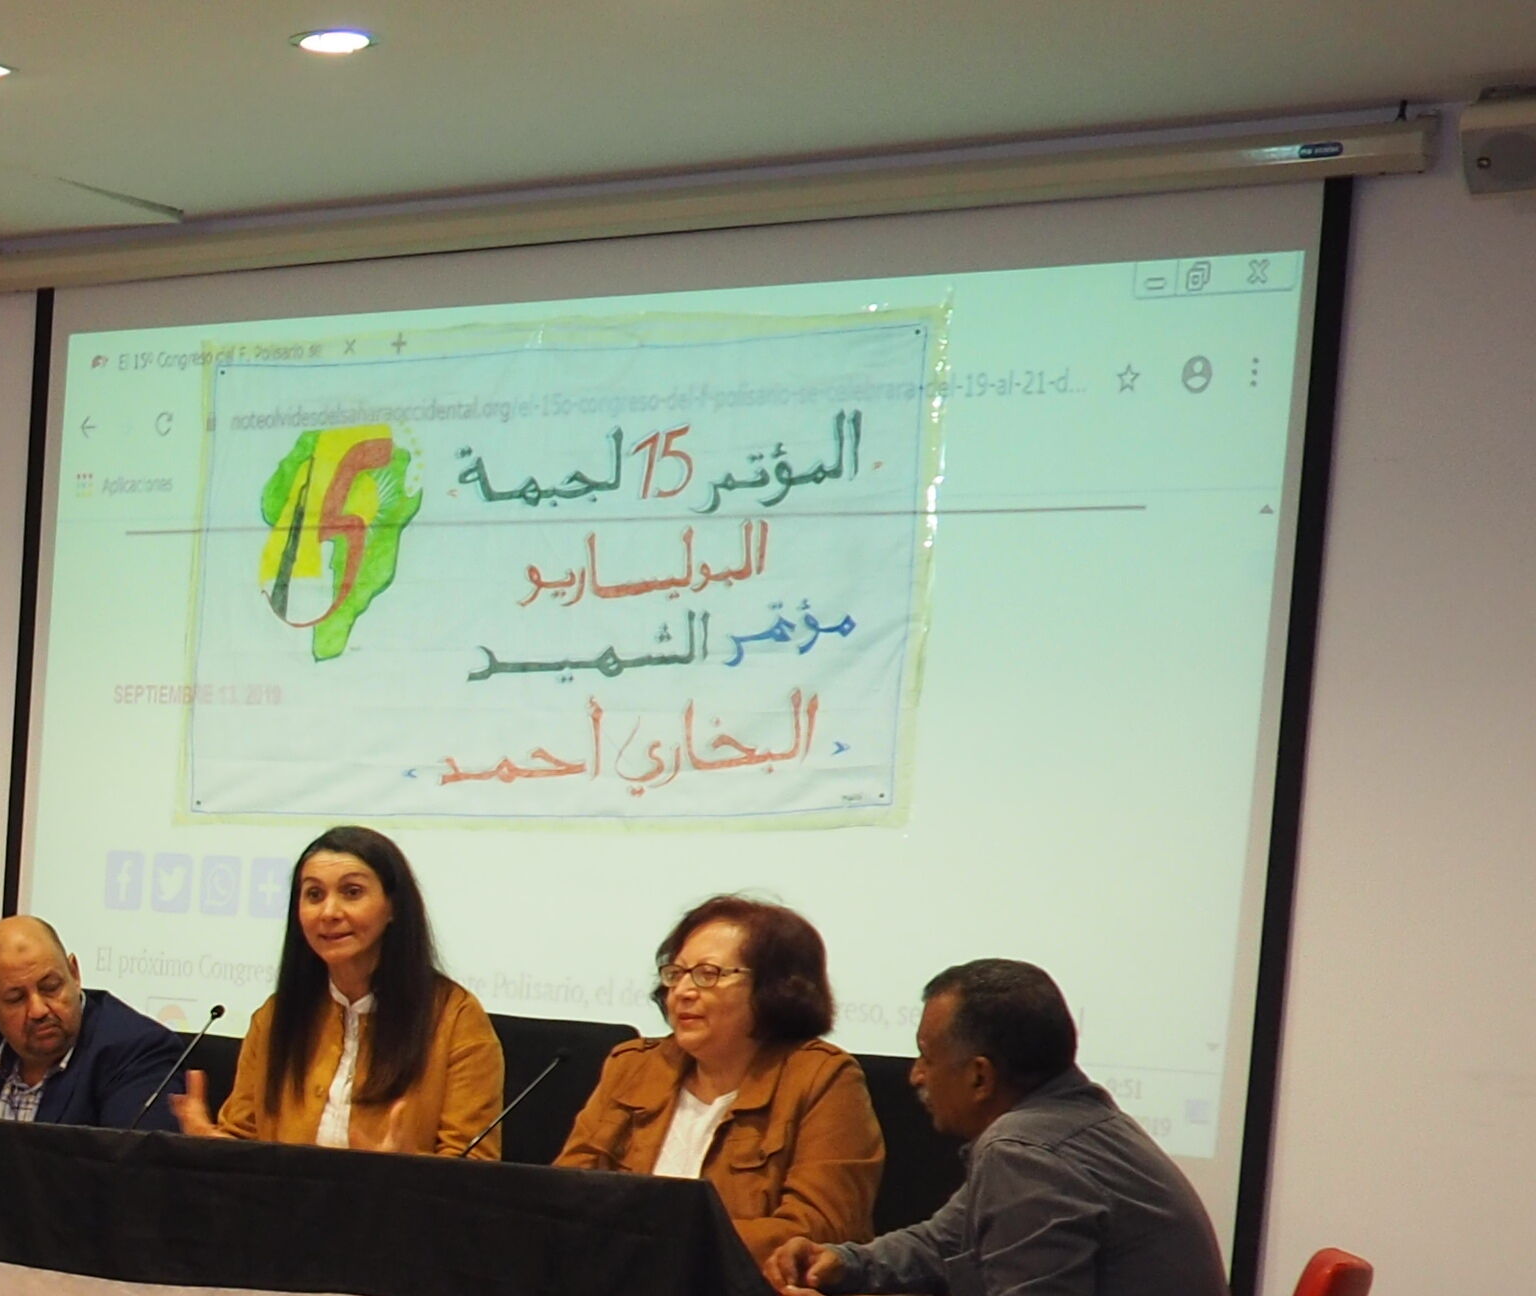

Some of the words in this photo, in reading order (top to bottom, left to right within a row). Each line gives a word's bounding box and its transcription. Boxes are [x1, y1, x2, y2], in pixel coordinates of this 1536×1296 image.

[454, 425, 624, 507] لجبهة
[631, 424, 694, 499] 15
[691, 410, 861, 513] المؤتمر
[518, 519, 769, 606] البوليساريو
[467, 611, 711, 683] الشهيد
[724, 599, 857, 666] مؤتمر
[615, 687, 819, 796] البخاري
[96, 946, 112, 972] El
[118, 949, 193, 979] próximo
[198, 953, 278, 986] Congres
